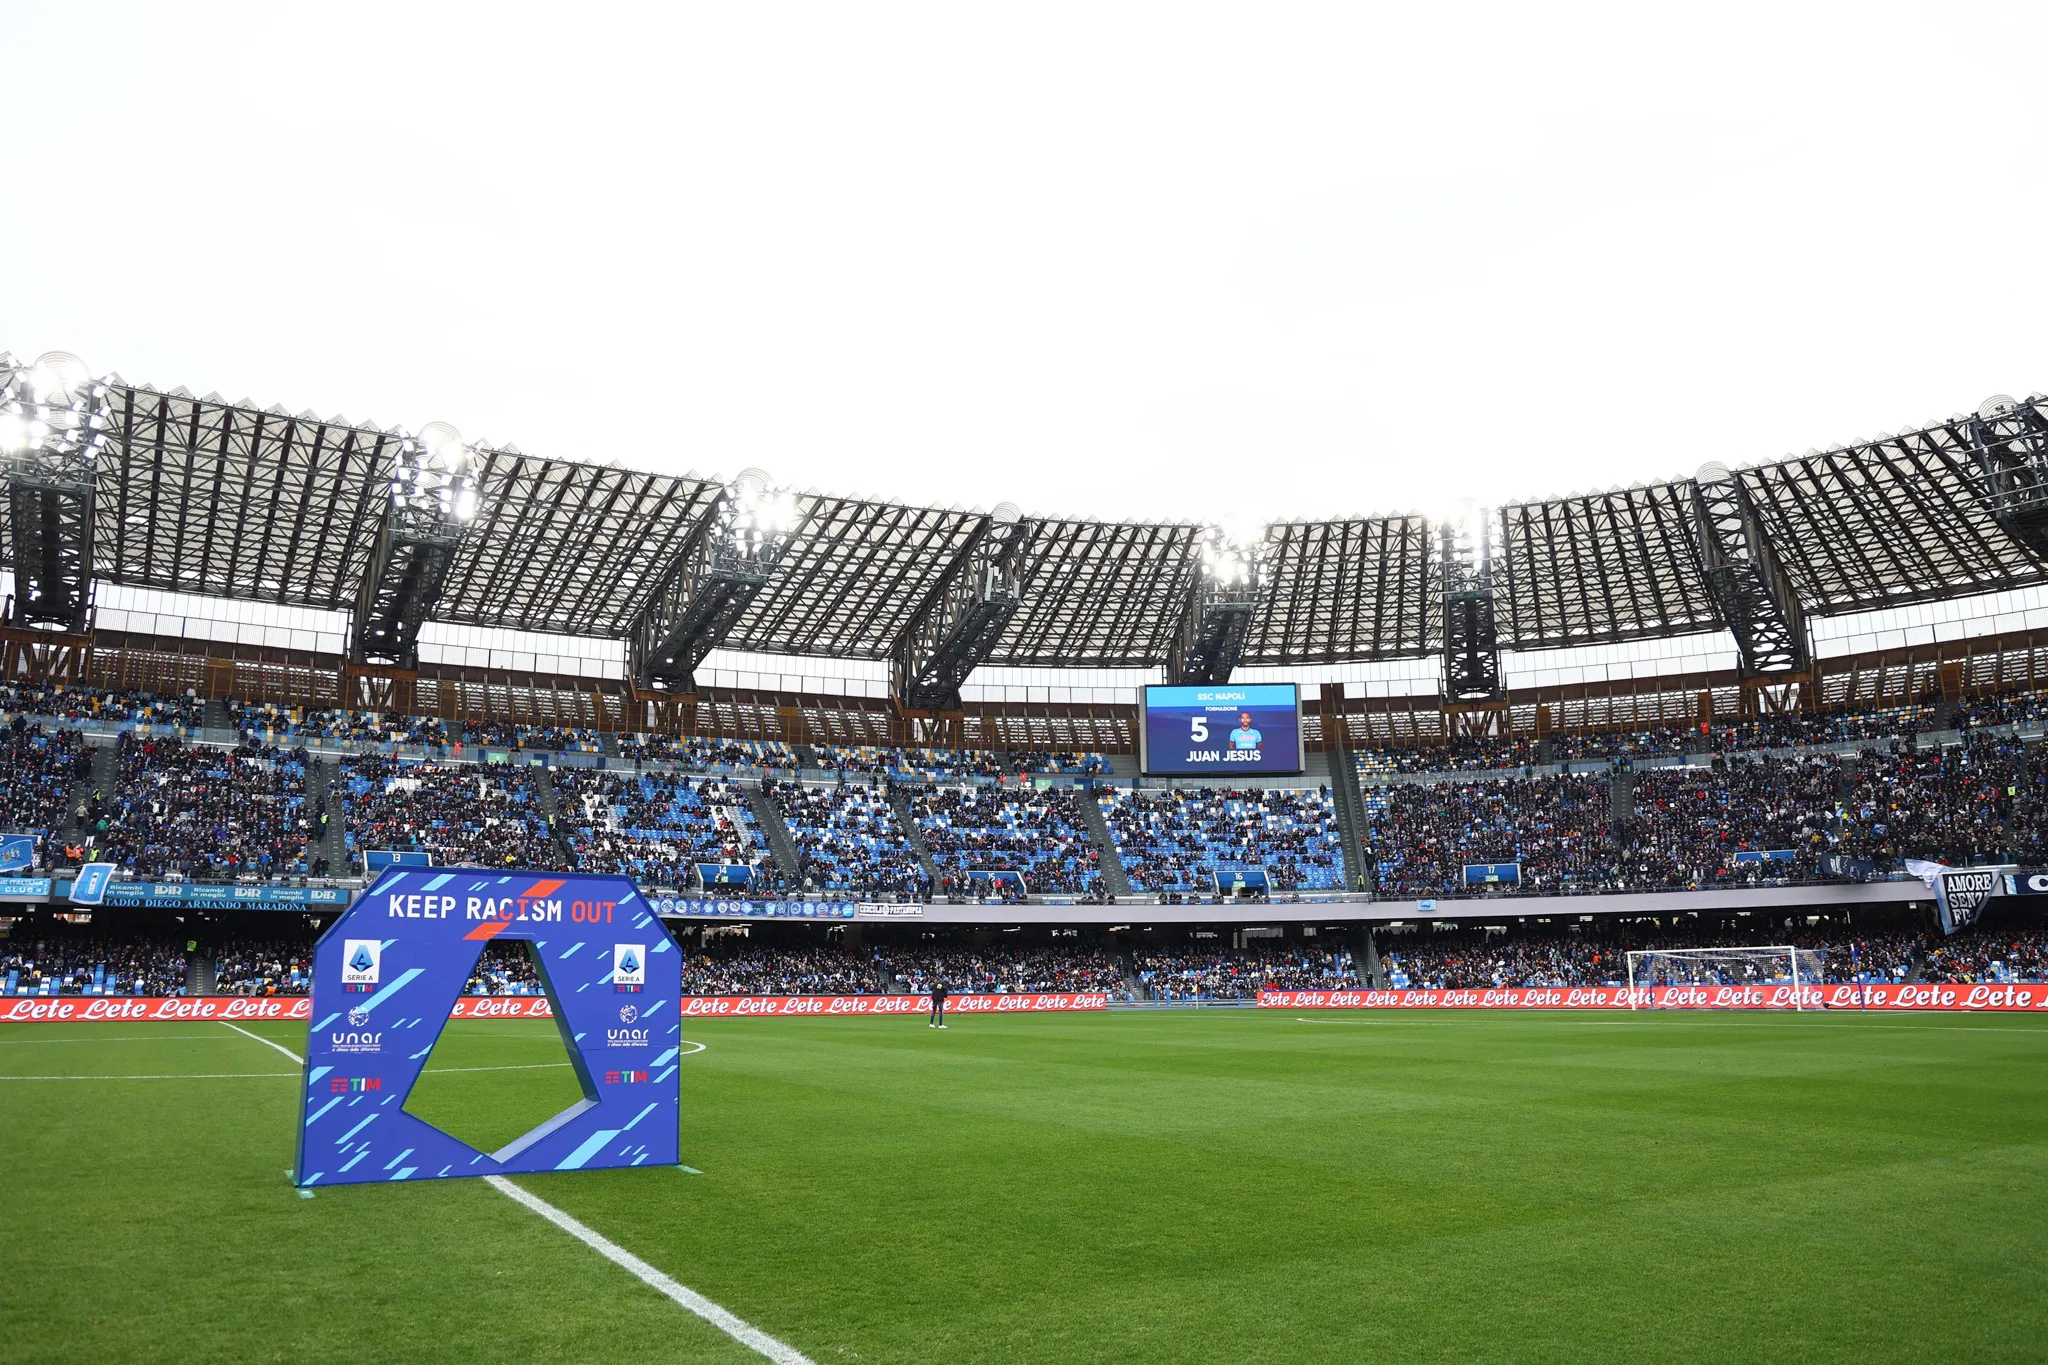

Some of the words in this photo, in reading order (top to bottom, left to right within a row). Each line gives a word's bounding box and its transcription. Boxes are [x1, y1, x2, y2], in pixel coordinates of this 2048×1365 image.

[1197, 693, 1214, 701] SSC
[1215, 692, 1246, 701] NAPOLI
[1190, 716, 1209, 743] 5
[1185, 750, 1220, 762] JUAN
[1222, 749, 1262, 762] JESUS
[392, 854, 401, 863] 13
[718, 865, 727, 875] 14
[987, 872, 996, 880] 15
[1487, 865, 1495, 874] 17
[1234, 872, 1243, 881] 16
[1947, 874, 1992, 892] AMORE
[101, 898, 140, 907] TADIO
[146, 899, 181, 908] DIEGO
[186, 900, 241, 909] ARMANDO
[247, 902, 307, 911] MARADONA
[389, 894, 456, 919] KEEP
[466, 897, 562, 922] RACISM
[571, 901, 617, 923] OUT
[357, 984, 373, 992] TIM
[1260, 991, 1290, 1006] Lete
[1291, 991, 1324, 1007] Lete
[1326, 991, 1360, 1007] Lete
[1361, 991, 1398, 1007] Lete
[1400, 990, 1437, 1007] Lete
[1439, 990, 1477, 1007] Lete
[1478, 989, 1518, 1007] Lete
[1520, 989, 1561, 1007] Lete
[1563, 989, 1606, 1007] Lete
[1658, 987, 1707, 1007] Lete
[1889, 986, 1956, 1007] Lete
[1960, 986, 2032, 1008] Lete
[1, 999, 74, 1020] Lete
[76, 999, 147, 1020] Lete
[149, 999, 217, 1019] Lete
[217, 998, 282, 1018] Lete
[466, 998, 522, 1017] Lete
[683, 998, 729, 1015] Lete
[731, 998, 777, 1014] Lete
[778, 998, 824, 1014] Lete
[825, 998, 868, 1013] Lete
[869, 997, 911, 1013] Lete
[953, 996, 992, 1012] Lete
[993, 996, 1030, 1011] Lete
[1031, 995, 1068, 1010] Lete
[1069, 994, 1105, 1010] Lete
[332, 1032, 382, 1044] unar
[607, 1029, 649, 1040] unar
[621, 1070, 647, 1083] TIM
[351, 1078, 381, 1091] TIM
